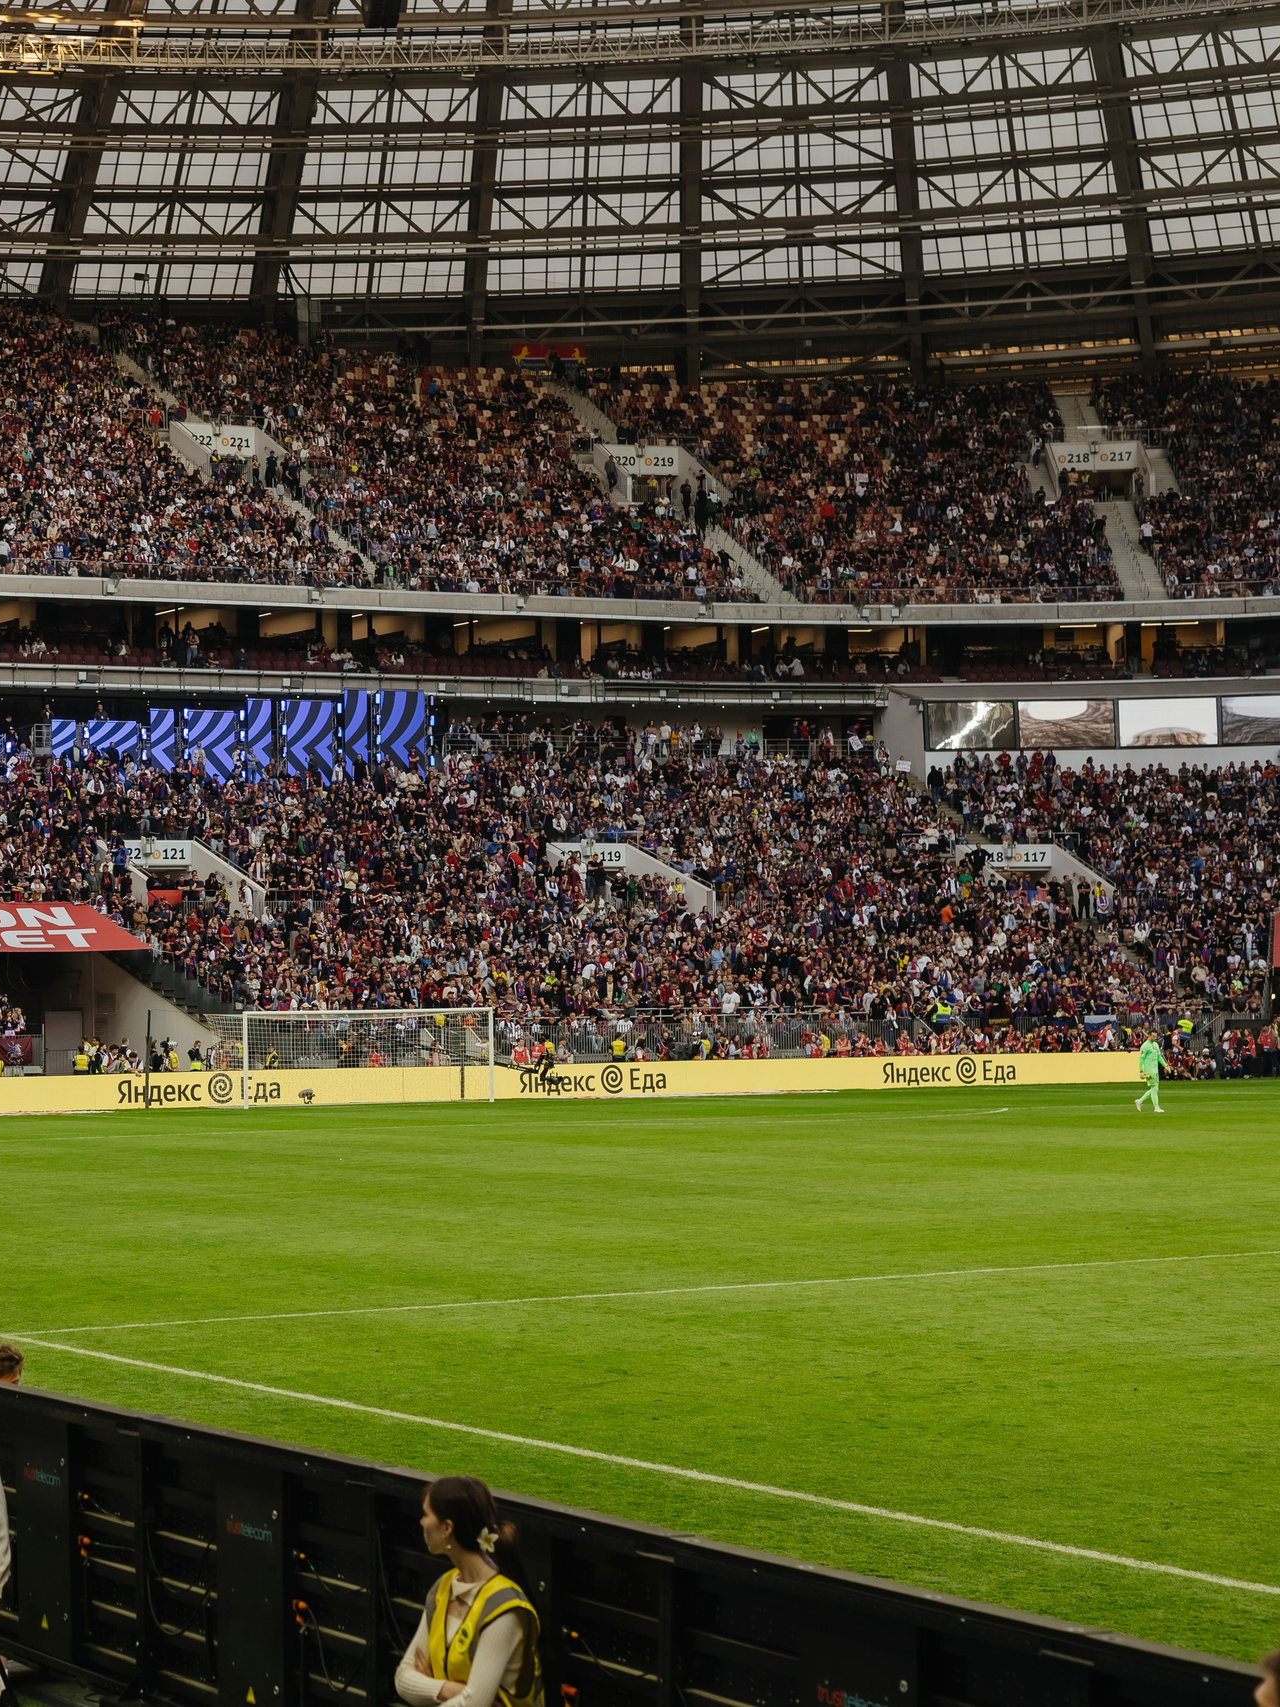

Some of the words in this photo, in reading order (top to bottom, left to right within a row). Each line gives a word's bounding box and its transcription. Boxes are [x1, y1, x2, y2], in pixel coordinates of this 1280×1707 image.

[230, 437, 251, 448] 221
[653, 457, 674, 466] 219
[1067, 453, 1090, 463] 218
[1109, 452, 1132, 462] 217
[162, 848, 186, 860] 121
[601, 850, 621, 862] 119
[1023, 852, 1046, 862] 117
[883, 1063, 951, 1086] Яндекс
[983, 1060, 1016, 1084] Еда
[629, 1068, 667, 1093] Еда
[118, 1080, 202, 1105] Яндекс
[240, 1076, 281, 1102] Еда
